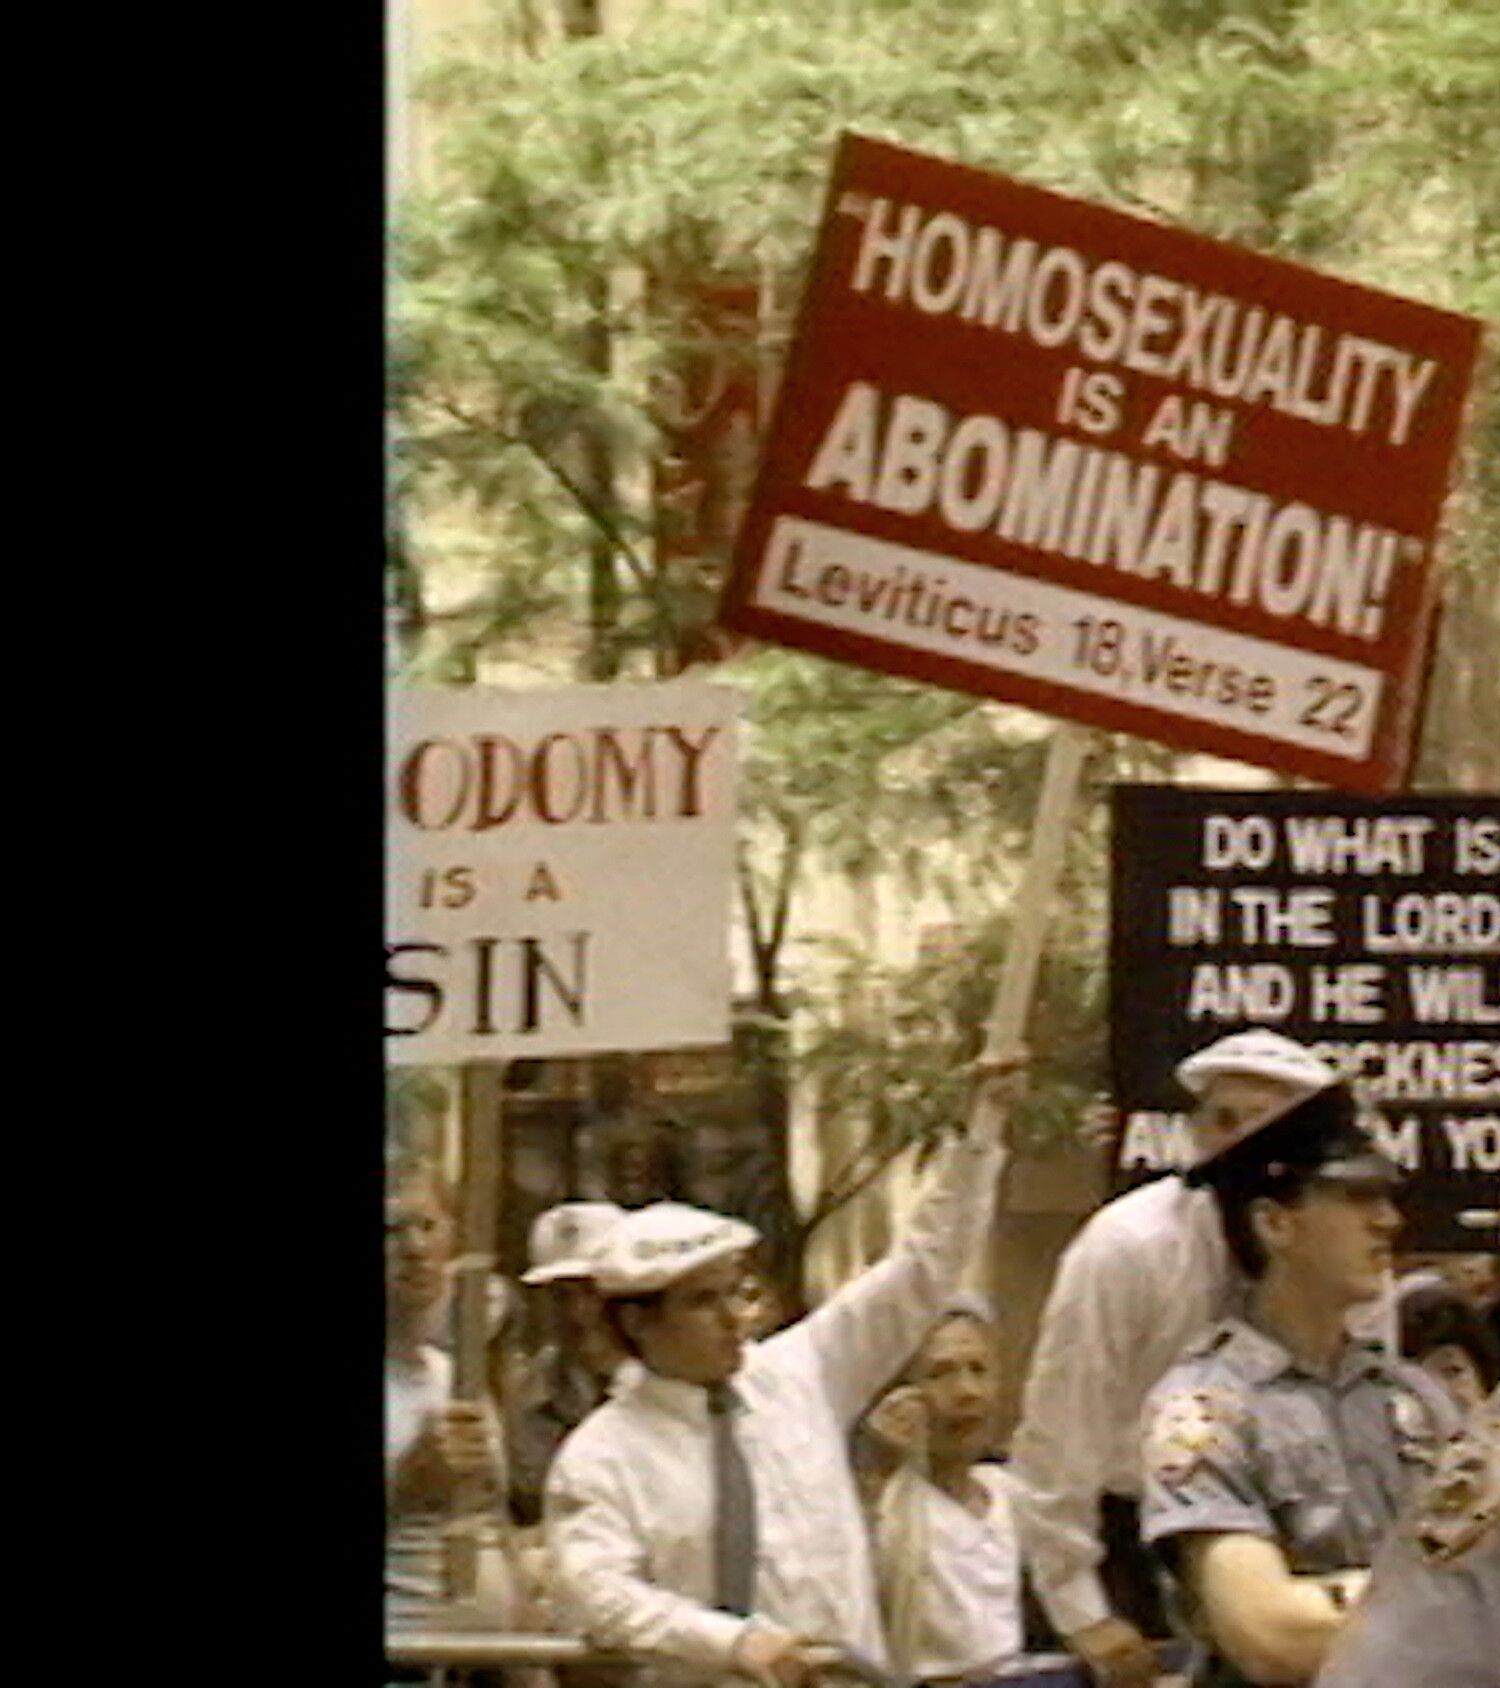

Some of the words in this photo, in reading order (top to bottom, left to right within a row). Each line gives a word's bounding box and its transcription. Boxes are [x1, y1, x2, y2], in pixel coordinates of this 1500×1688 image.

[1056, 367, 1127, 434] IS
[1142, 393, 1236, 467] AN
[776, 540, 1044, 657] Leviticus
[1297, 674, 1364, 740] 22
[401, 725, 722, 831] ODOMY
[420, 867, 477, 910] IS
[524, 860, 561, 903] A
[1204, 816, 1275, 873] DO
[1285, 817, 1434, 876] WHAT
[1167, 886, 1221, 947] IN
[1231, 889, 1337, 949] THE
[384, 931, 590, 1036] SIN
[1187, 964, 1294, 1022] AND
[1311, 965, 1386, 1023] HE
